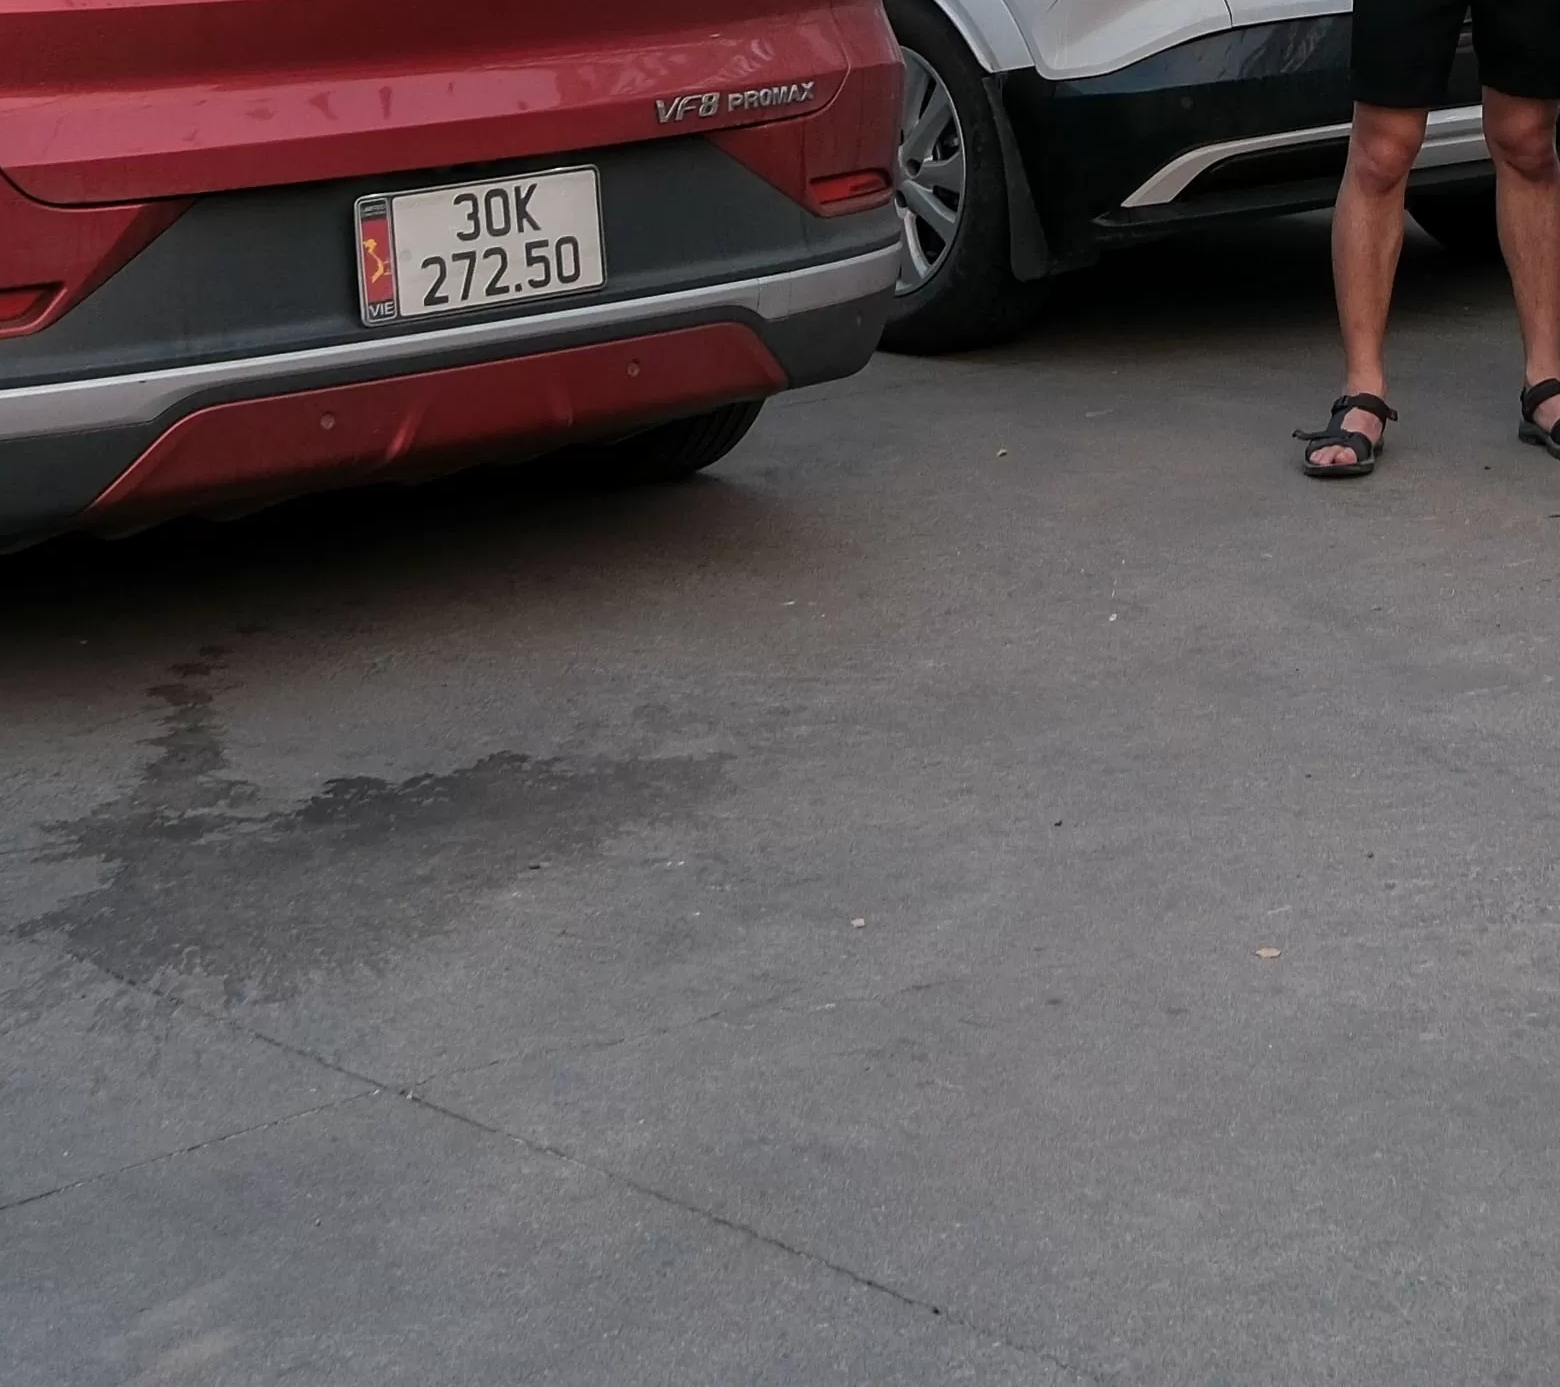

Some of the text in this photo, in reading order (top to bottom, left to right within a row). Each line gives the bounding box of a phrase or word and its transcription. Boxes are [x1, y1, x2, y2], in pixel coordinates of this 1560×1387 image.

[656, 81, 816, 125] VF8 PROMAX
[452, 182, 542, 242] 30K
[421, 235, 581, 307] 272.50
[368, 300, 395, 317] VIE
